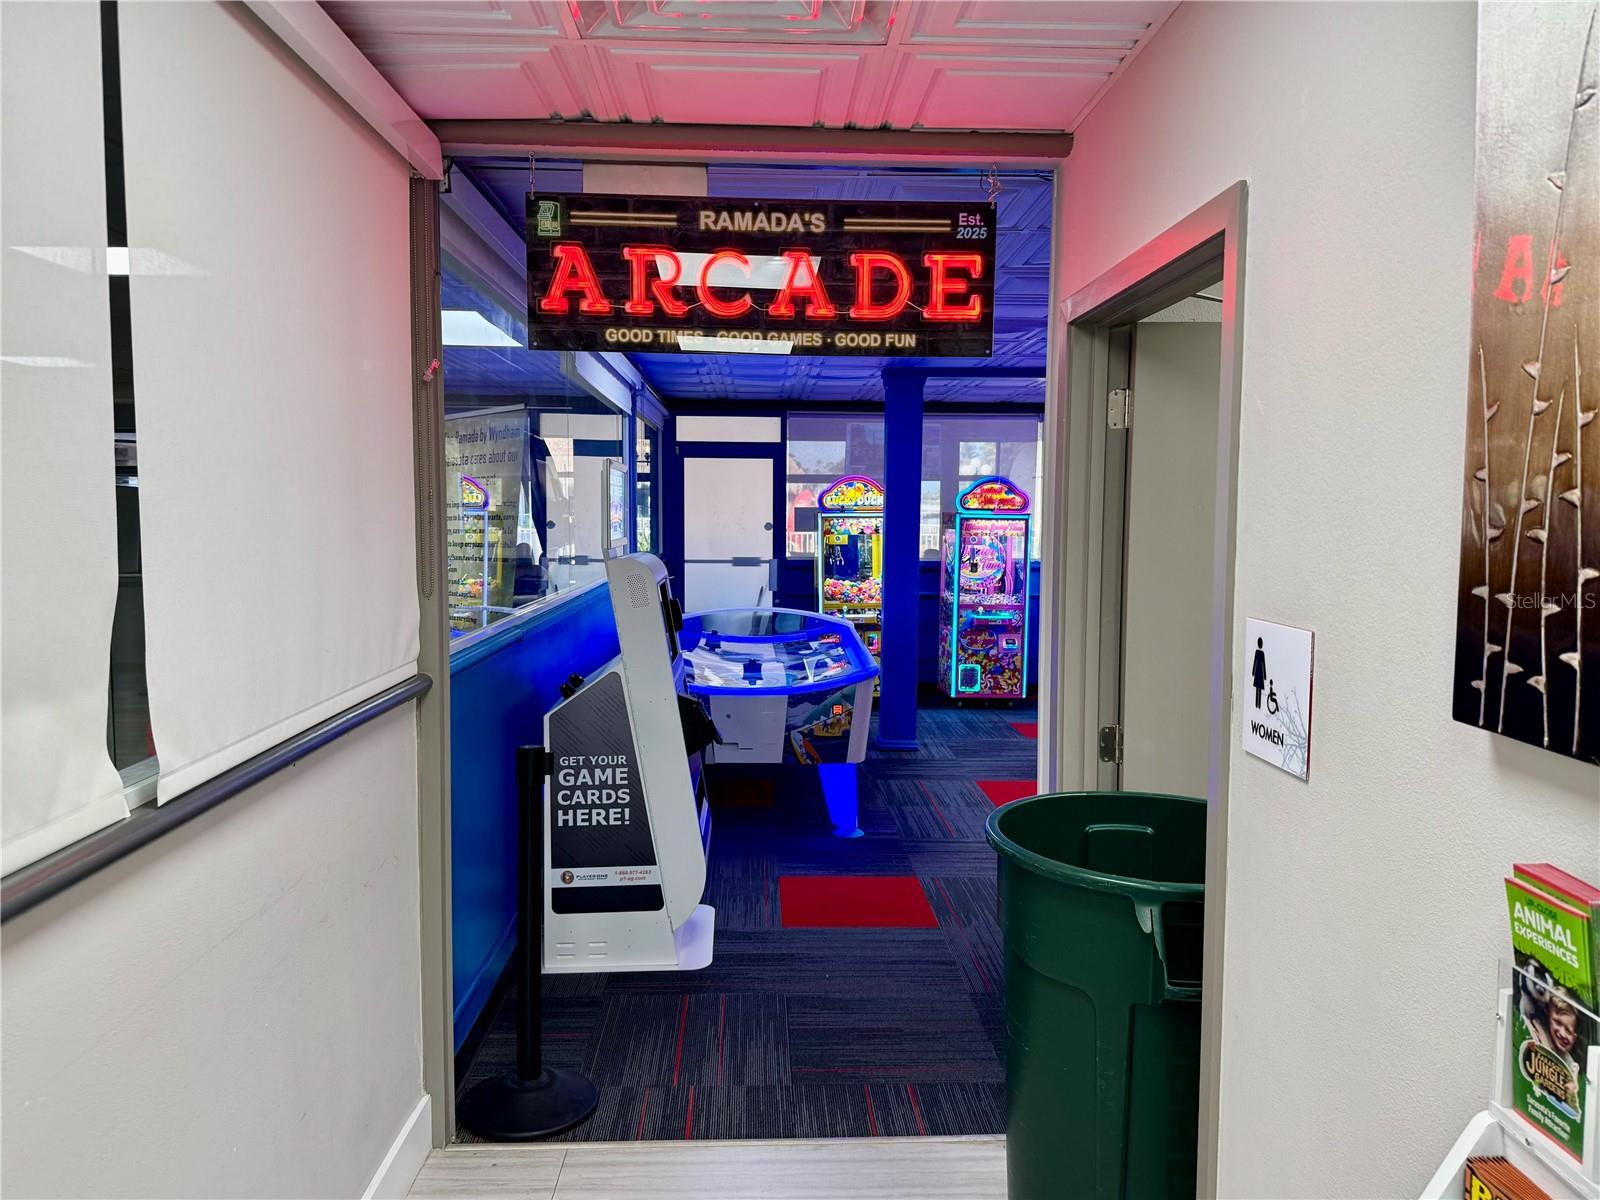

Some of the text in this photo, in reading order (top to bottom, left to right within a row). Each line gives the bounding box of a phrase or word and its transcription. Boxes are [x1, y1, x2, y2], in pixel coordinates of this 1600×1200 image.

[699, 210, 826, 233] RAMADA'S
[958, 212, 985, 226] Est.
[956, 227, 988, 240] 2025
[538, 243, 983, 321] ARCADE
[605, 328, 653, 343] GOOD
[657, 329, 704, 344] TIMES
[767, 332, 823, 346] GAMES
[835, 333, 882, 347] GOOD
[885, 334, 917, 347] FUN
[1251, 720, 1284, 747] WOMEN
[560, 755, 627, 766] GET YOUR
[558, 768, 629, 786] GAME
[557, 789, 631, 805] CARDS
[557, 808, 630, 827] HERE!
[1513, 901, 1577, 953] ANIMAL
[1513, 921, 1579, 969] EXPERIENCES
[1526, 1052, 1566, 1087] JUNGLE
